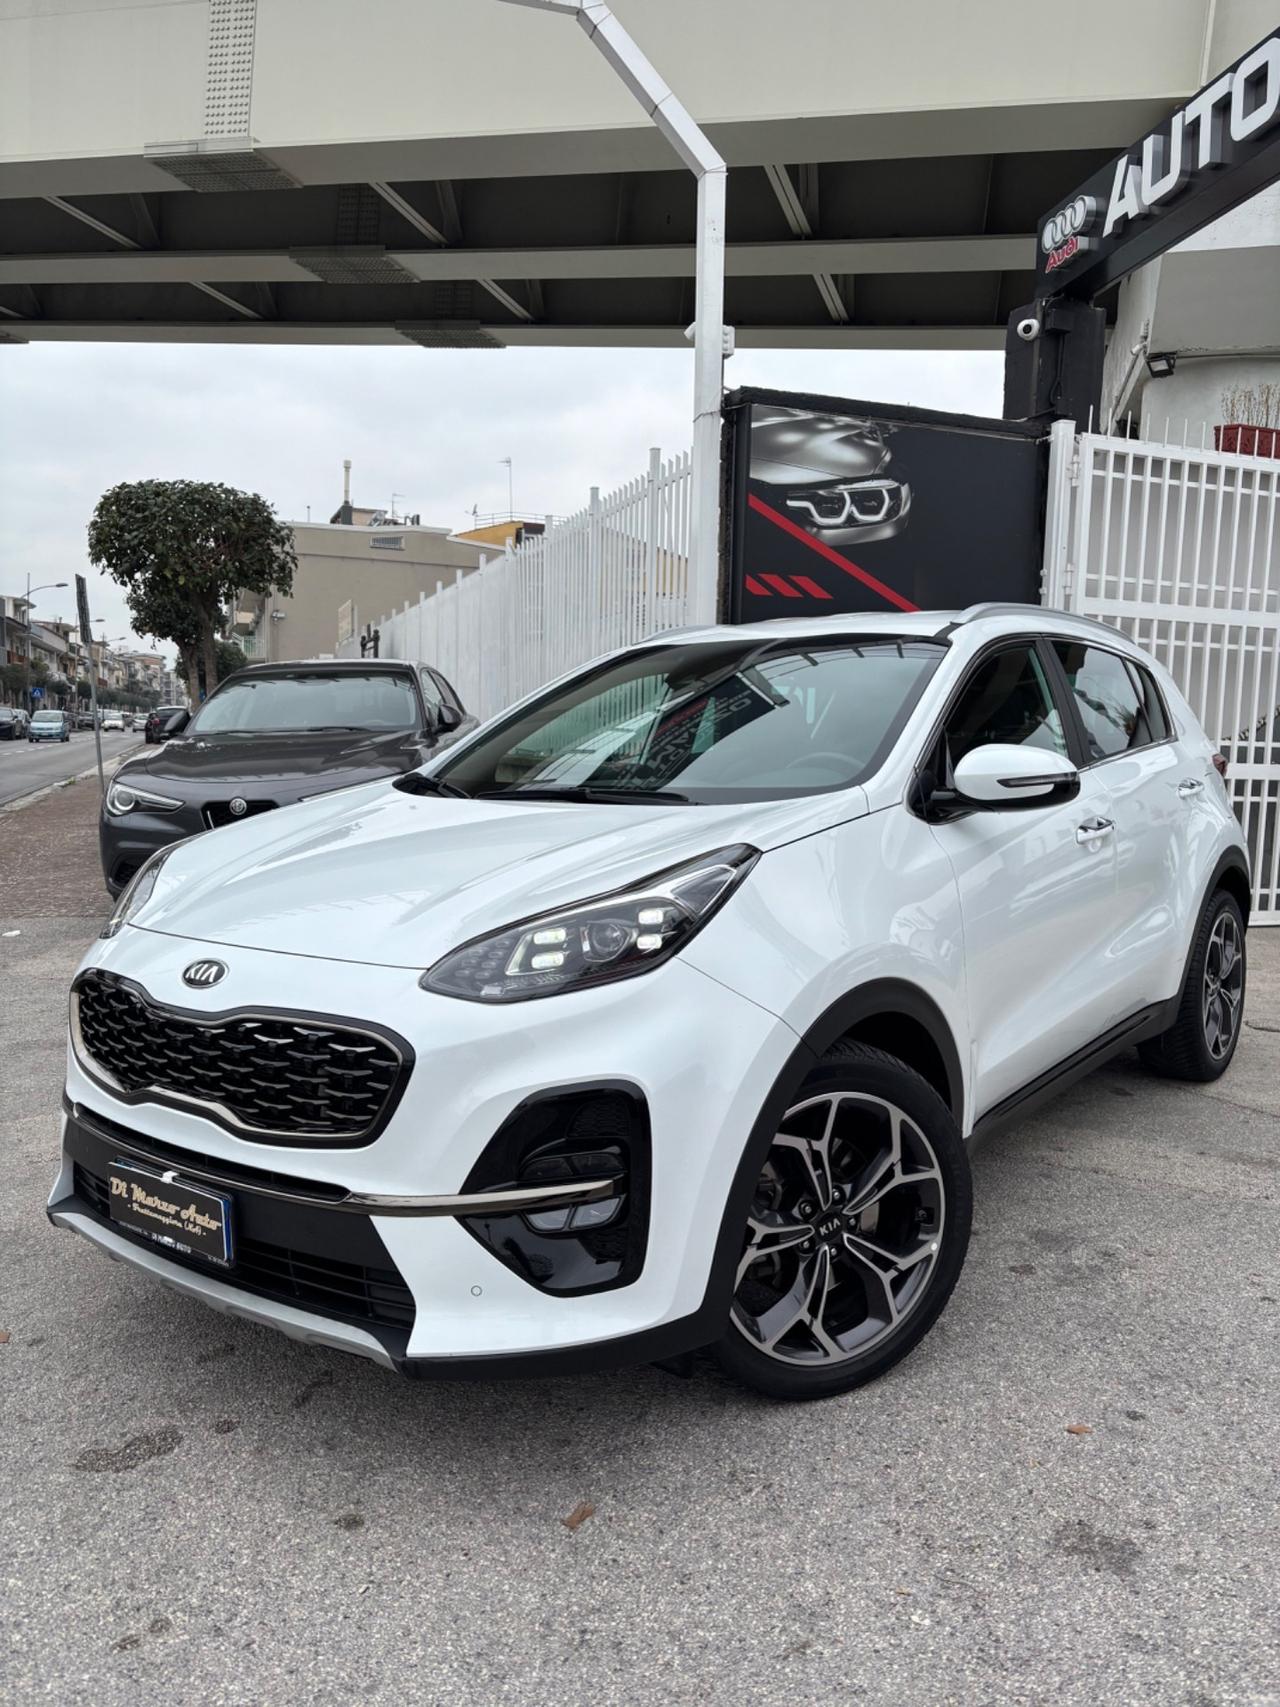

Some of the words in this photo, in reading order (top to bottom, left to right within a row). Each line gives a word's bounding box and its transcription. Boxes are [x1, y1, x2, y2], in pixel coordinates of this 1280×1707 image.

[1103, 37, 1280, 238] AUTO
[1045, 236, 1080, 273] Audi
[820, 1218, 841, 1236] KIA
